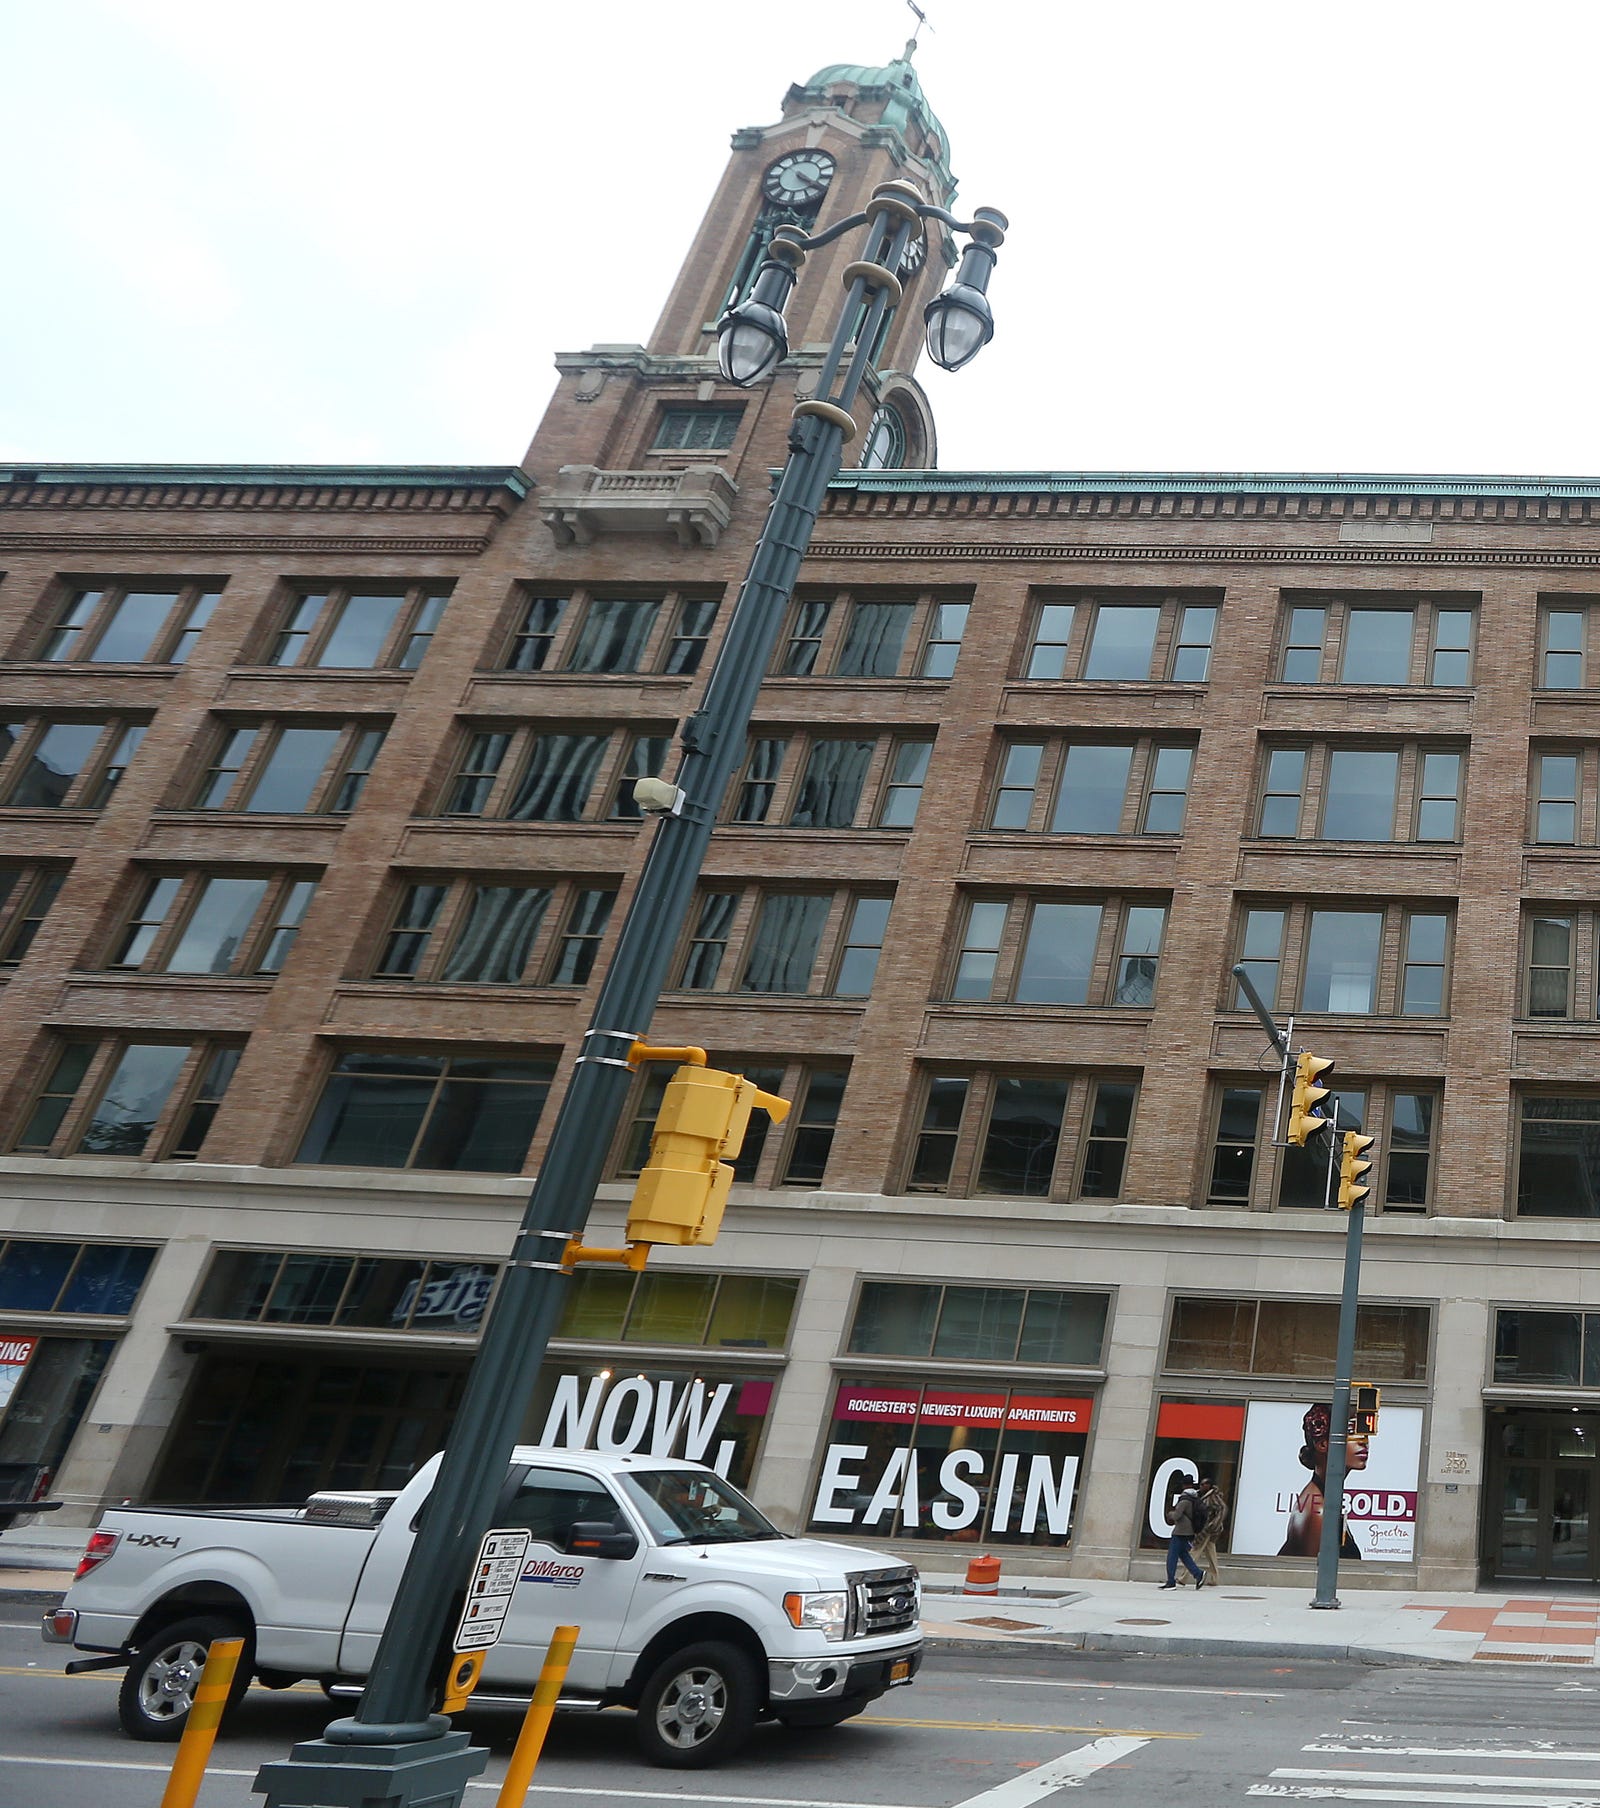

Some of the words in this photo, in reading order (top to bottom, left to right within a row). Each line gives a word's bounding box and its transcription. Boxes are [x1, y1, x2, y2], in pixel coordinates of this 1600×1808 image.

[539, 1375, 733, 1461] NOW
[848, 1399, 917, 1414] ROCHESTER'S
[920, 1403, 963, 1417] NEWEST
[964, 1406, 1005, 1419] LUXURY
[1008, 1408, 1077, 1423] APARTMENTS
[1276, 1492, 1322, 1514] LIVE
[1342, 1492, 1413, 1517] BOLD.
[1369, 1524, 1409, 1546] Spectra
[522, 1560, 584, 1578] DiMarco
